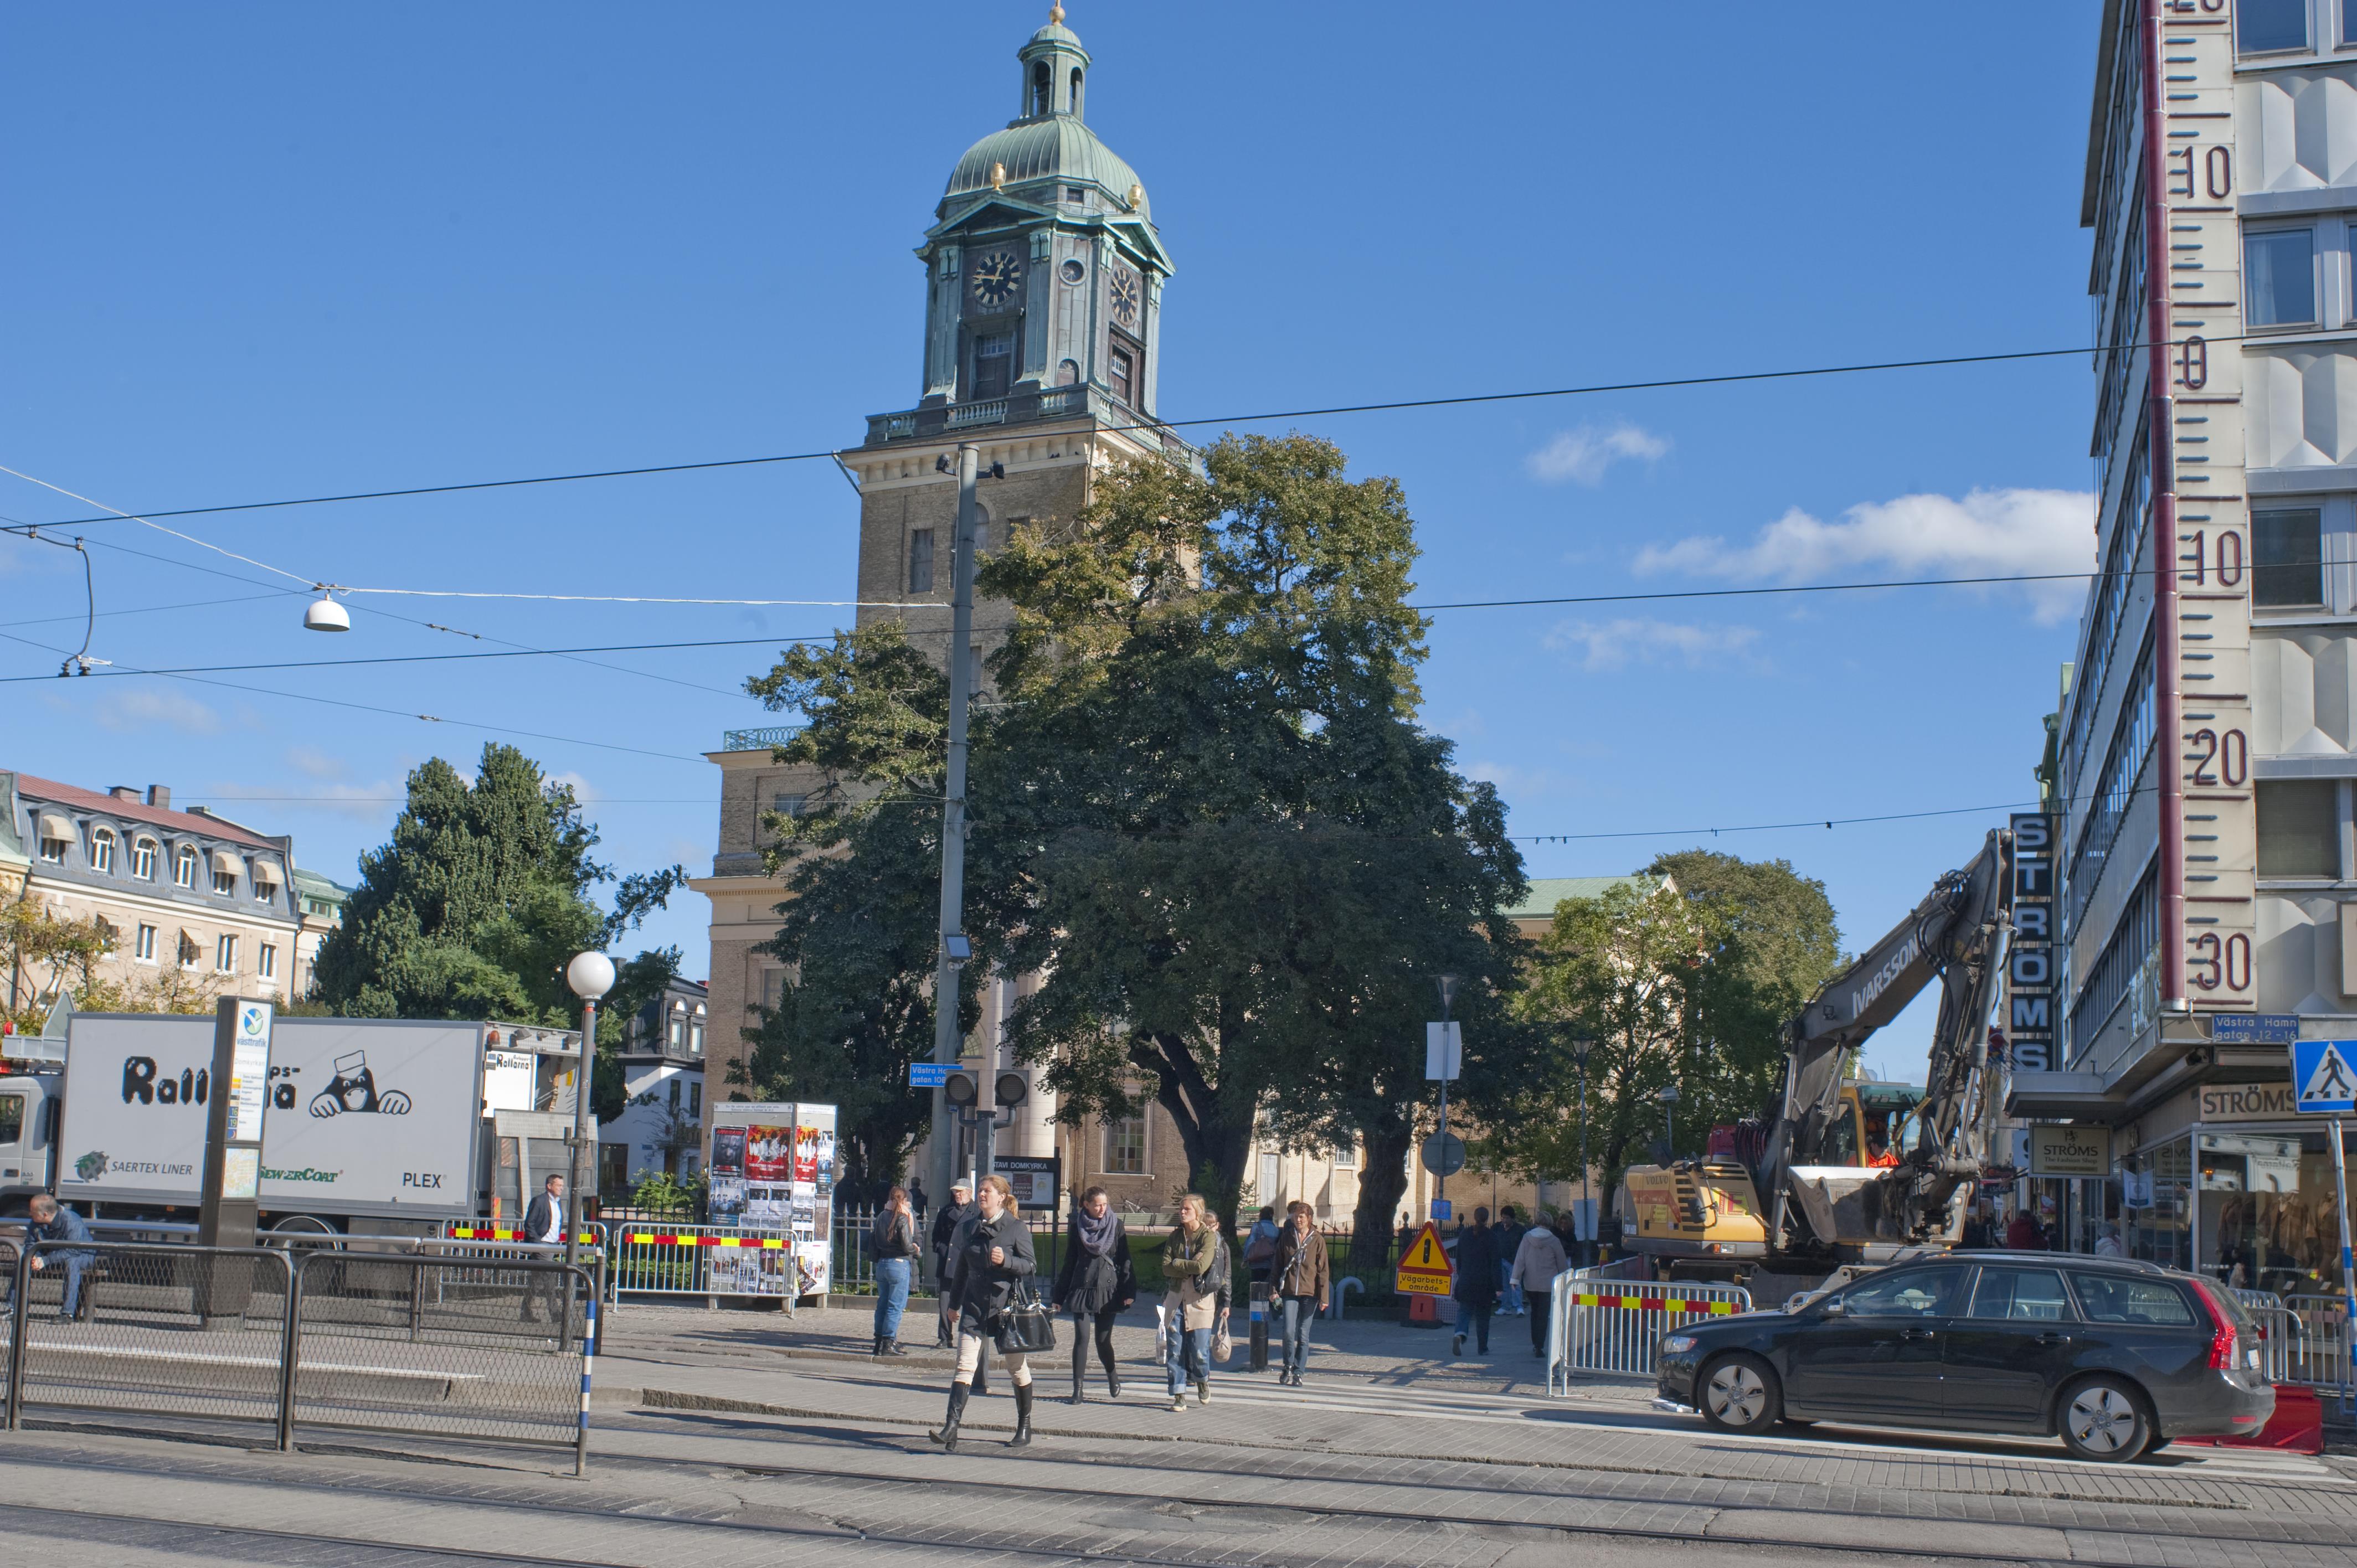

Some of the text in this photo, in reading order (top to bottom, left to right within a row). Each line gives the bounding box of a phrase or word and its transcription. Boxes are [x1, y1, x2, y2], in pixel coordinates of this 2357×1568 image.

[2180, 145, 2231, 200] 10
[2184, 336, 2207, 390] 0
[2191, 530, 2242, 587] 10
[2192, 728, 2247, 787] 20
[2195, 932, 2251, 992] 30
[2216, 1018, 2297, 1027] Västra Hamn
[237, 1036, 266, 1048] västtrafik
[2216, 1032, 2250, 1041] gatan
[2259, 1030, 2271, 1039] 12
[2284, 1030, 2297, 1040] 16
[2044, 1143, 2098, 1157] STRÖMS
[111, 1160, 193, 1175] SAERTEX LINER
[403, 1172, 441, 1188] PLEX
[1646, 1175, 1668, 1185] VOLVO
[1401, 1274, 1448, 1285] Vägarbets-
